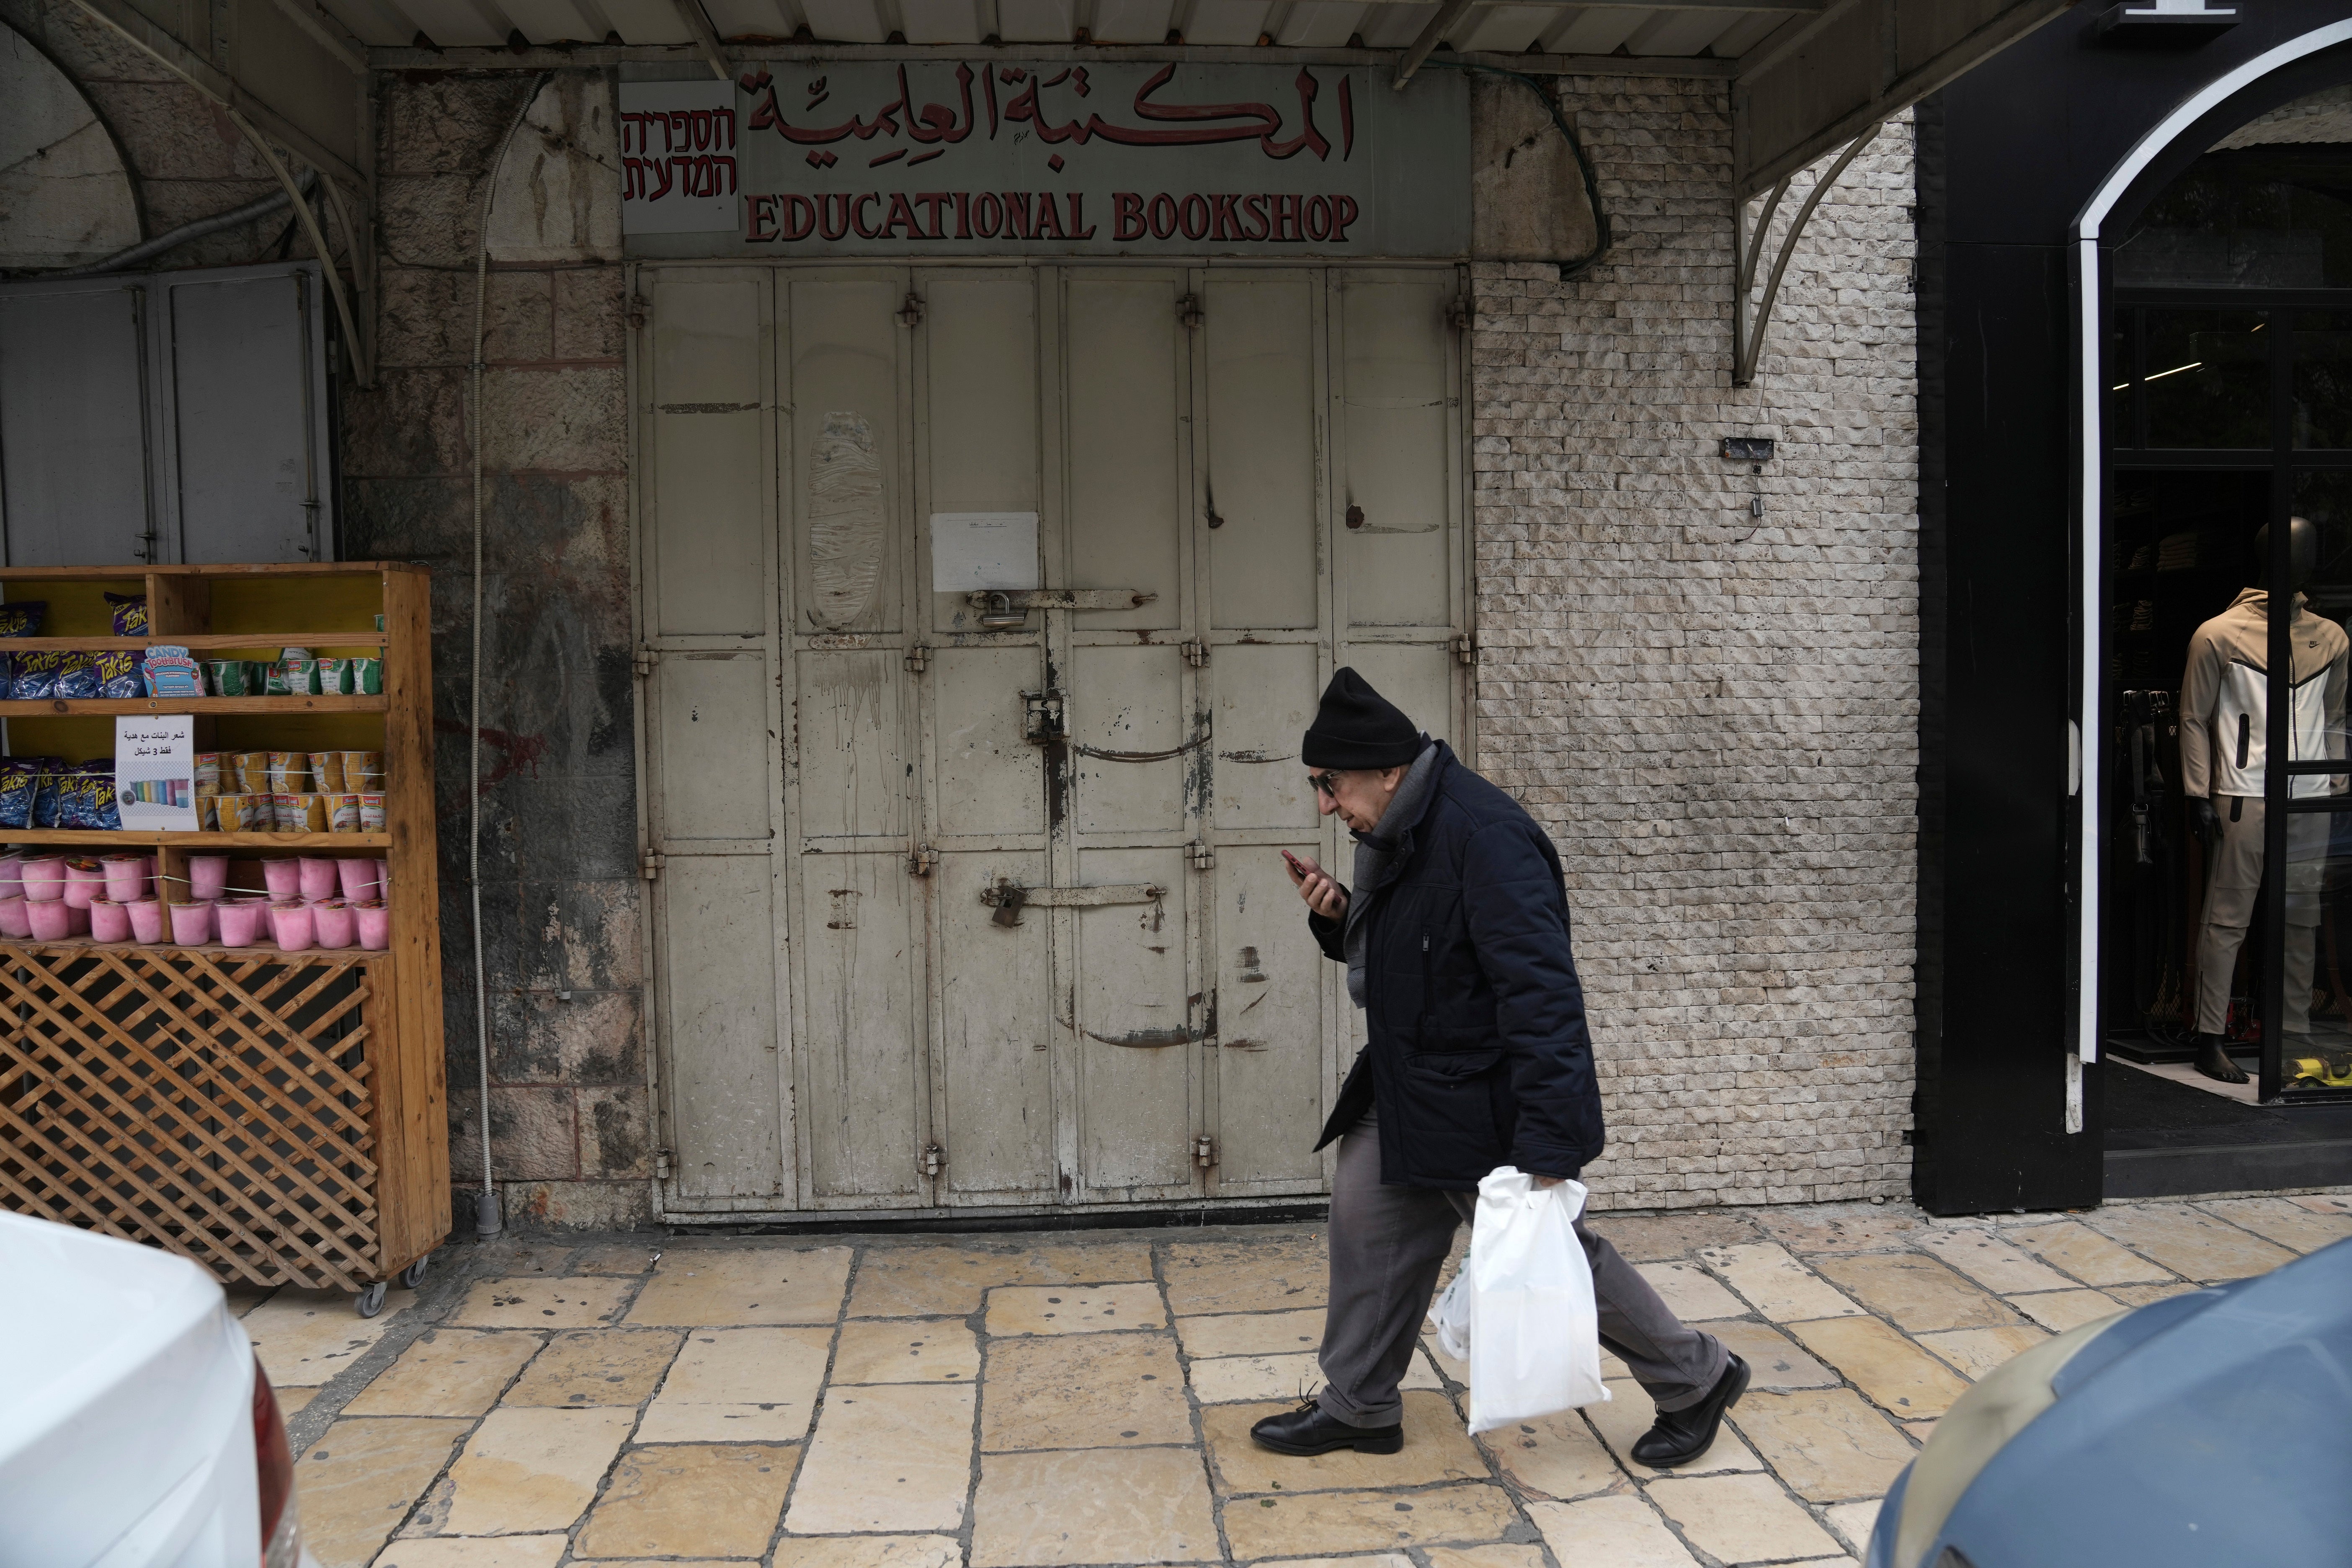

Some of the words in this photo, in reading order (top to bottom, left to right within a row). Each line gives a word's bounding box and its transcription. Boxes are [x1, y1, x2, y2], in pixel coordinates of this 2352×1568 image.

[620, 108, 736, 155] הספריה
[622, 154, 737, 202] המדעית
[744, 192, 1097, 242] EDUCATIONAL
[1112, 192, 1359, 242] BOOKSHOP
[122, 605, 147, 632] Tak
[147, 647, 188, 659] CANDY
[95, 655, 133, 685] Takis
[124, 731, 138, 741] هدية
[151, 732, 168, 740] البنات
[171, 731, 184, 740] شعر
[134, 747, 150, 756] شيكل
[95, 786, 115, 810] Tak
